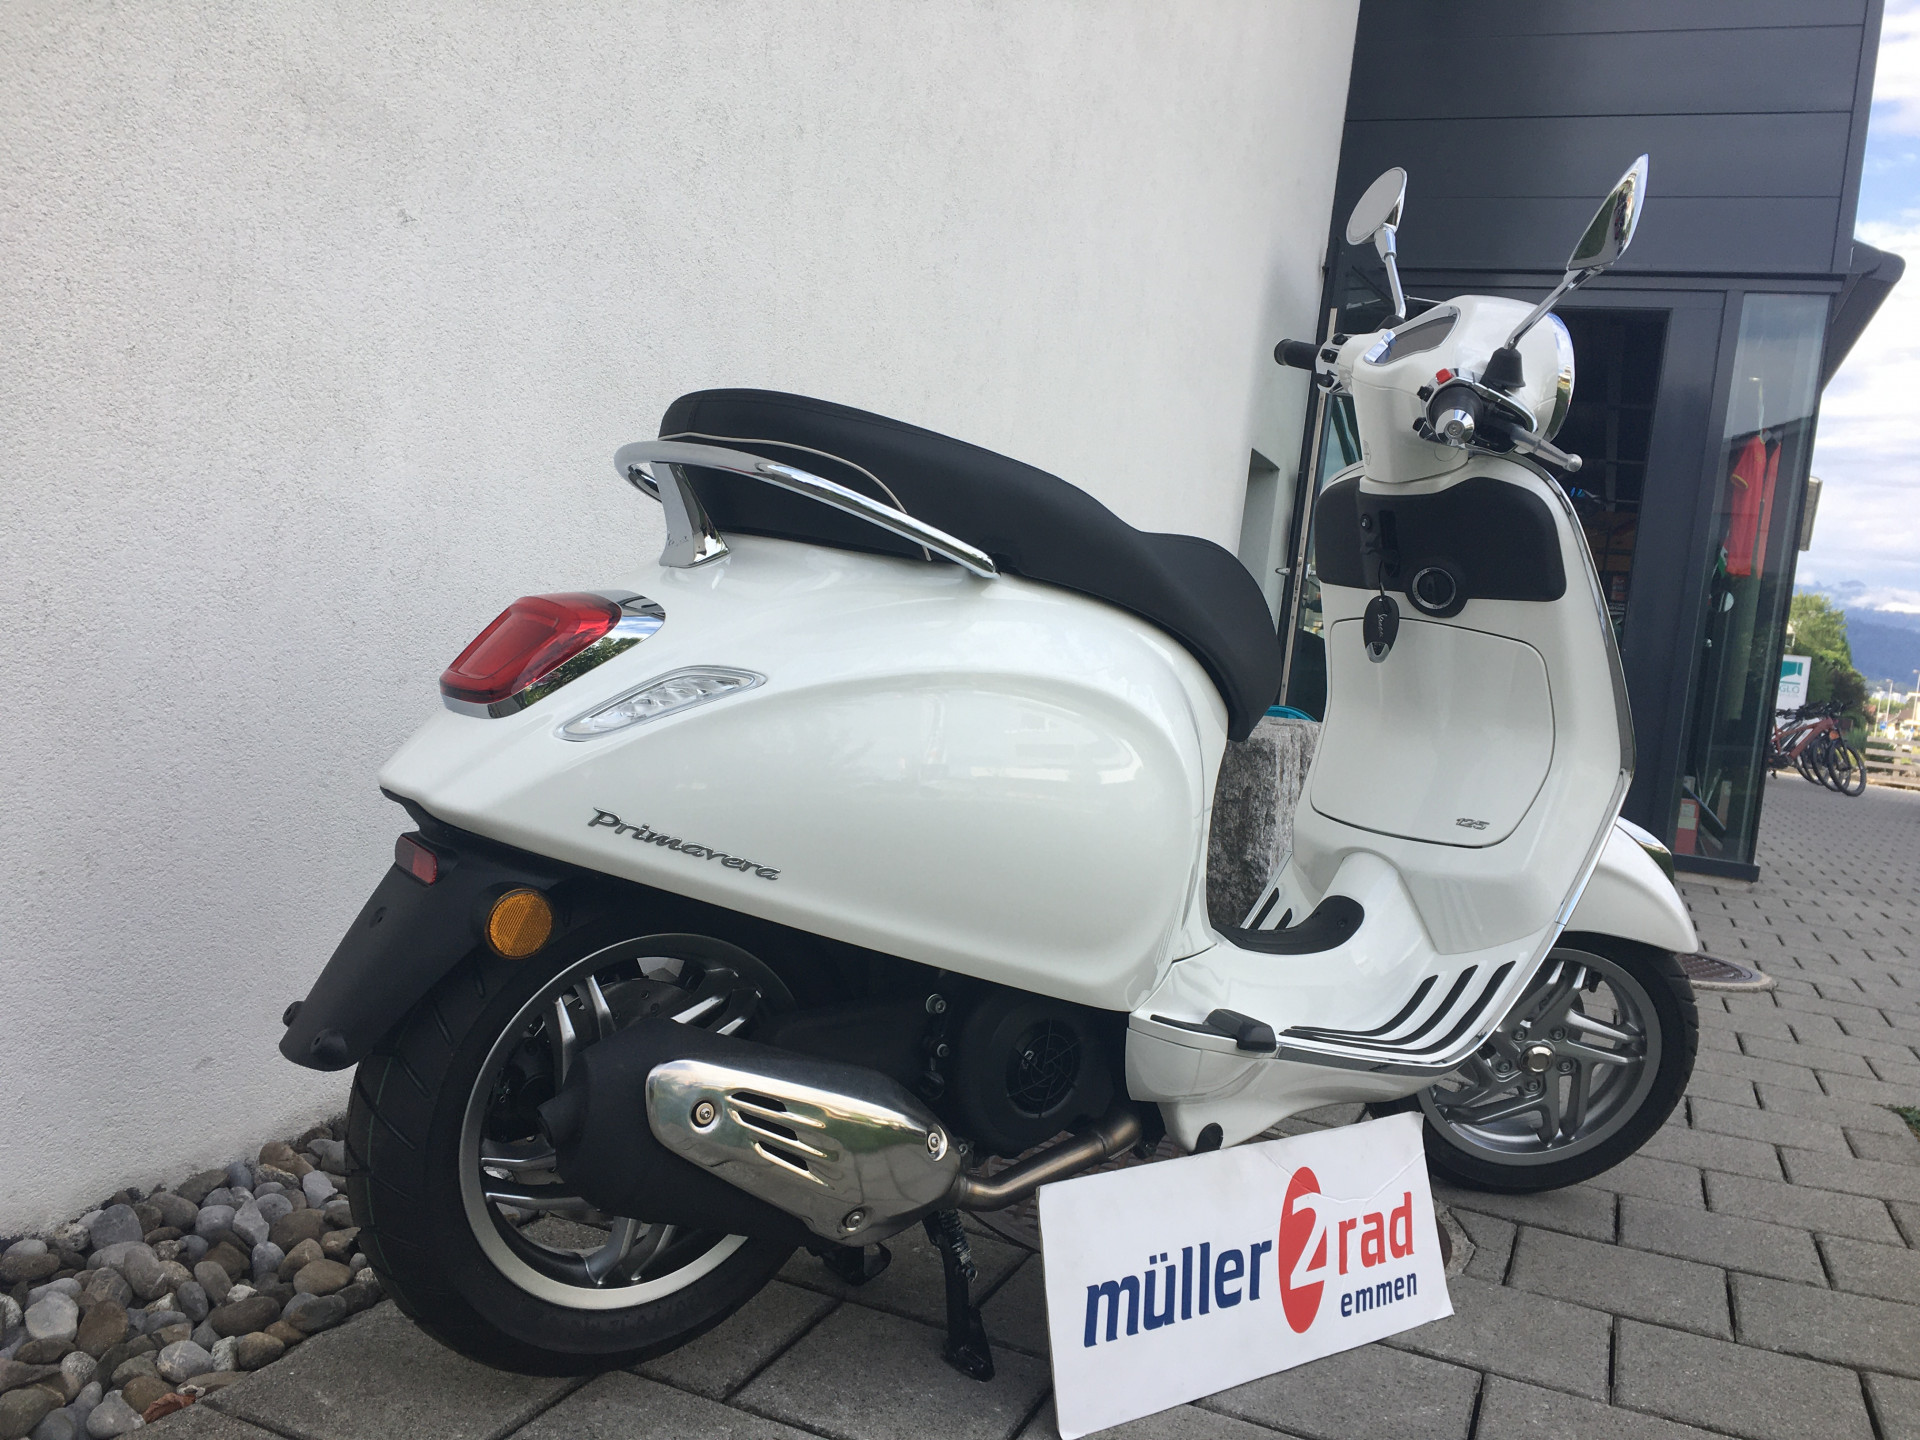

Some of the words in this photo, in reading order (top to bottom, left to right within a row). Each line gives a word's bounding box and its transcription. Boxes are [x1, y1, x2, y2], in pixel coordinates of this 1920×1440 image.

[587, 806, 782, 881] Primavera
[1083, 1240, 1273, 1348] müller
[1340, 1272, 1418, 1318] emmen
